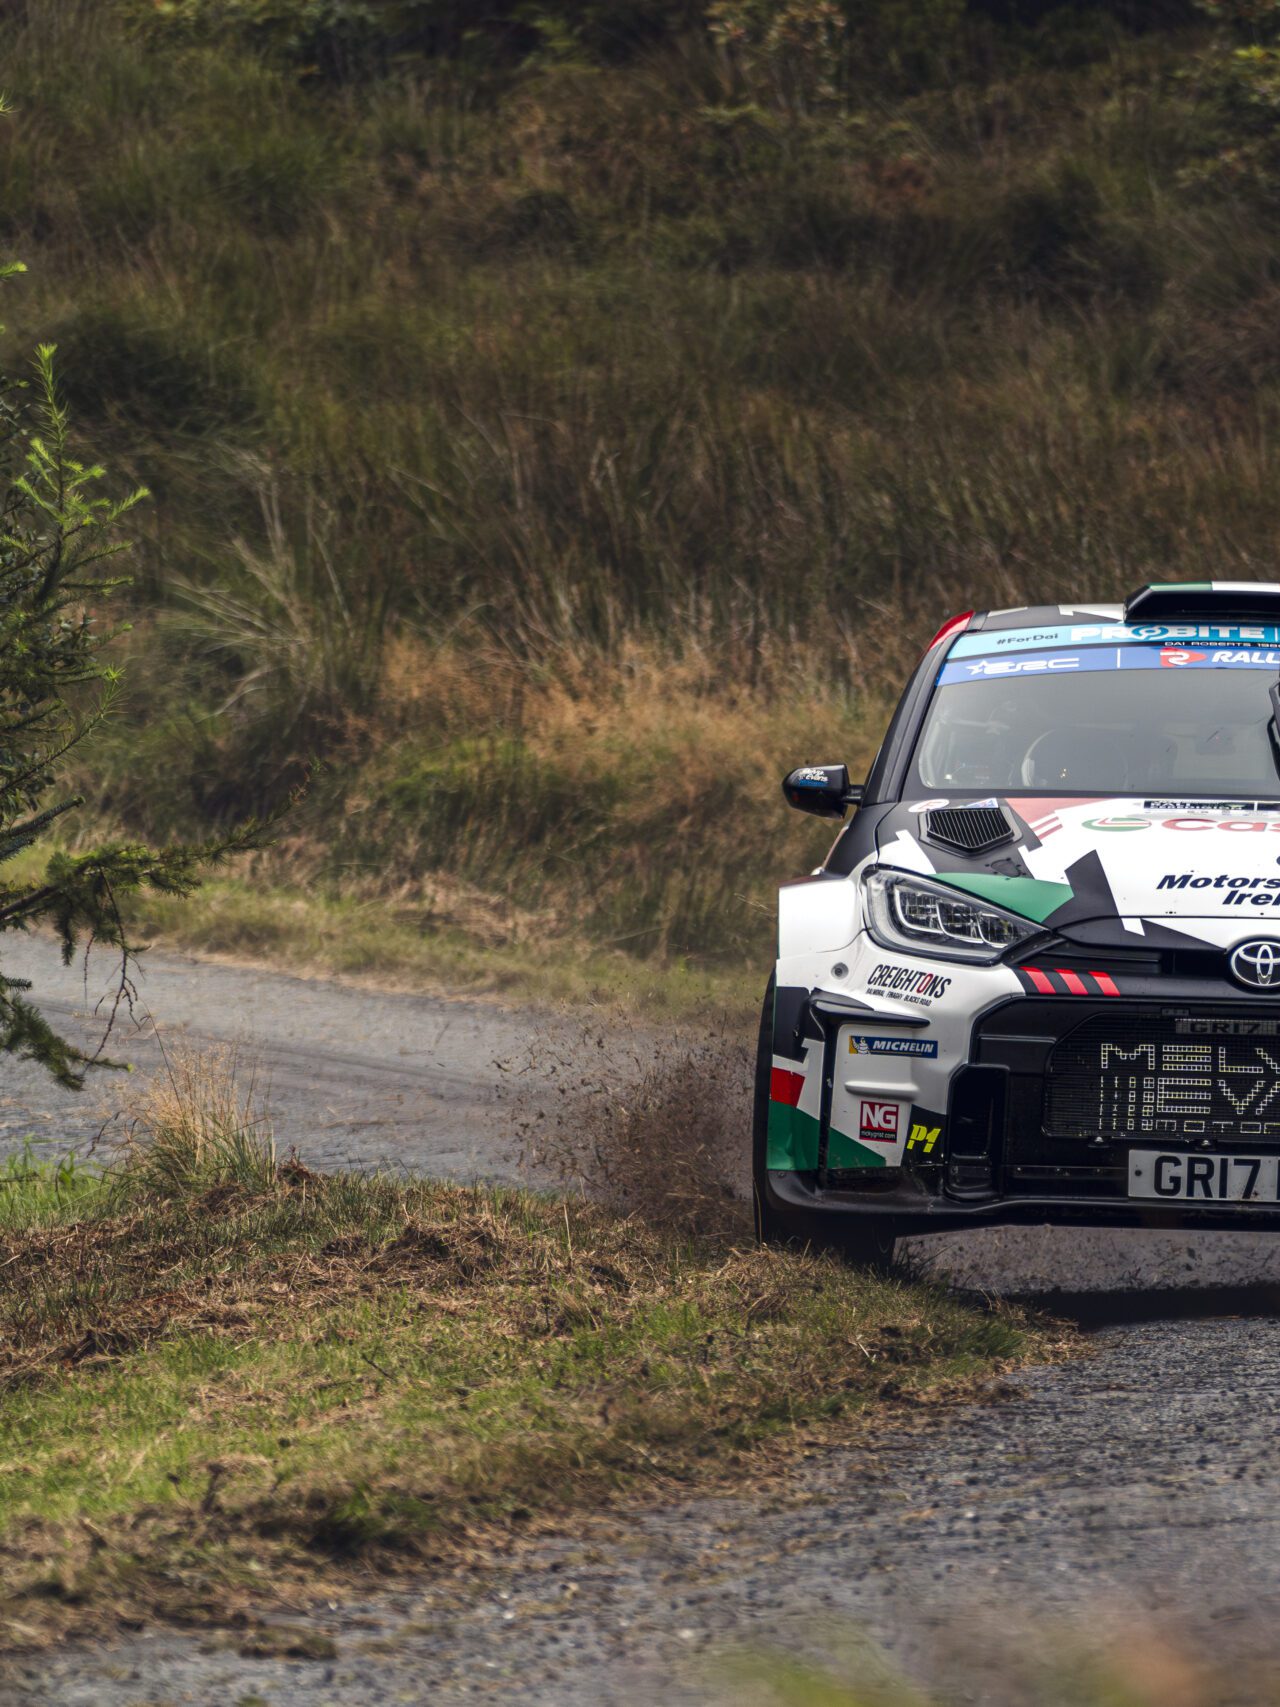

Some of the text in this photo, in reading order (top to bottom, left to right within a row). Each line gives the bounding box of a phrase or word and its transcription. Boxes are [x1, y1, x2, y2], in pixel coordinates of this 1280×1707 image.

[997, 633, 1059, 645] #ForDai
[1071, 625, 1264, 641] PROBITE
[867, 964, 952, 999] CREIGHTONS
[873, 1041, 934, 1053] MICHELIN
[862, 1103, 898, 1130] NG
[861, 1130, 896, 1140] nickygrist.com
[906, 1124, 941, 1153] P1
[1153, 1155, 1262, 1200] GR17
